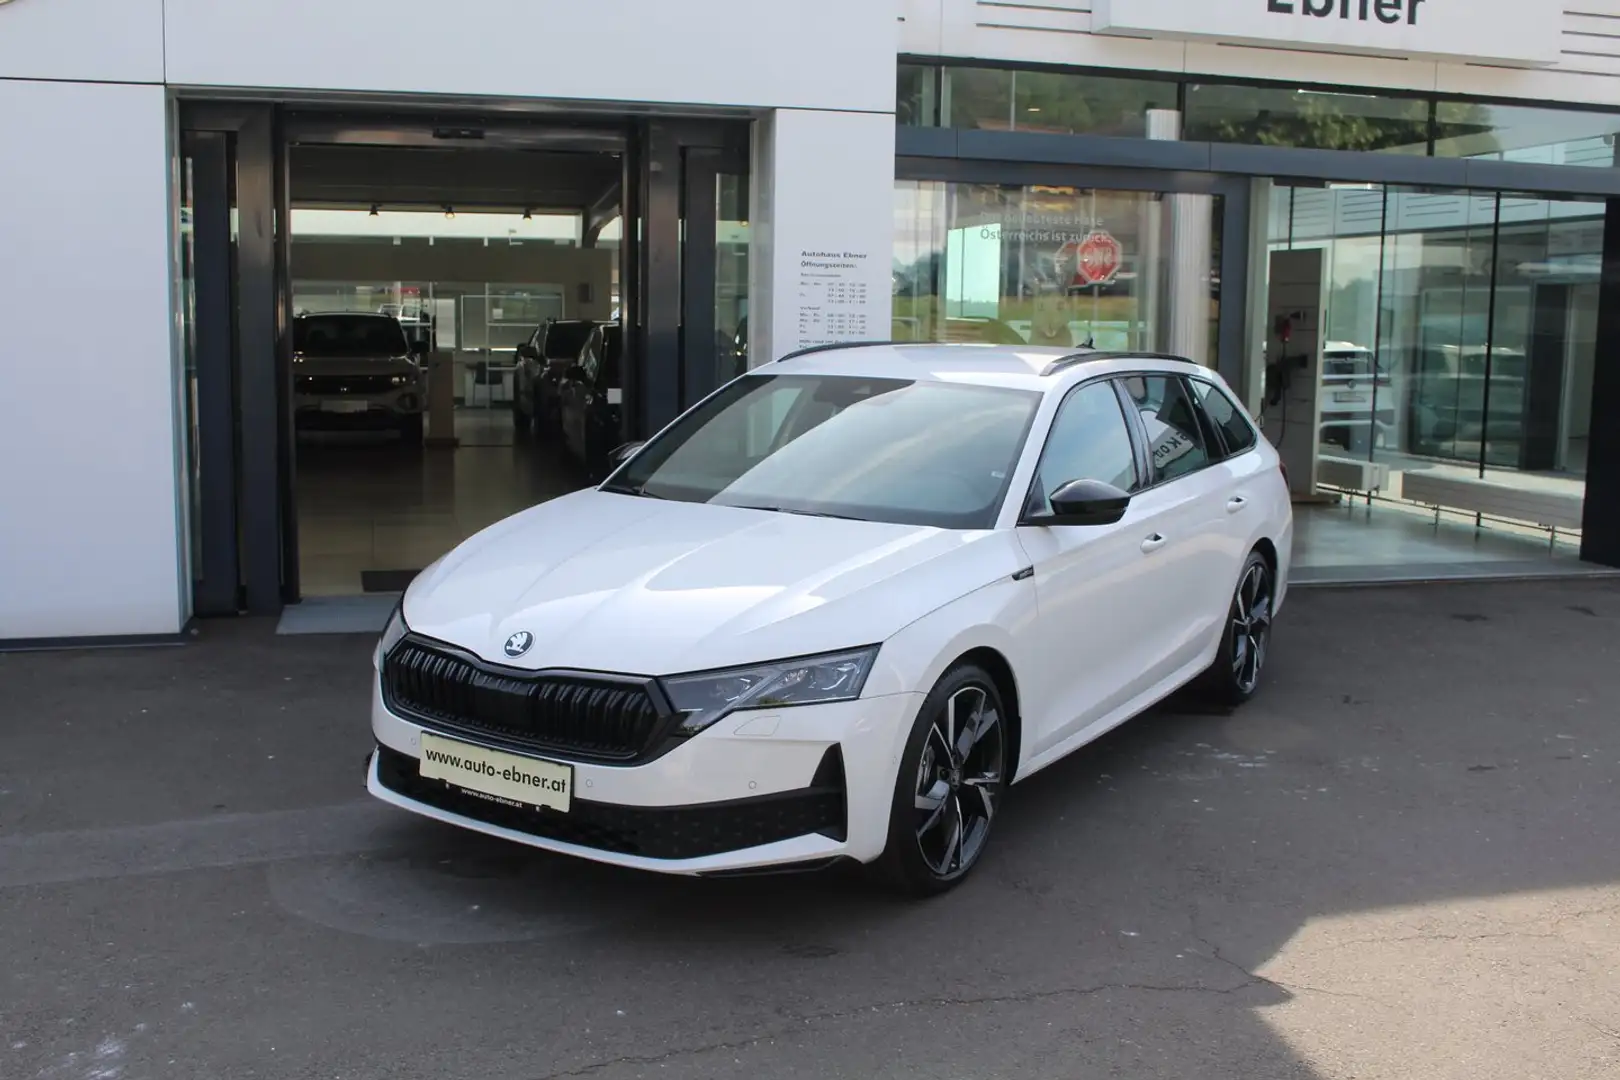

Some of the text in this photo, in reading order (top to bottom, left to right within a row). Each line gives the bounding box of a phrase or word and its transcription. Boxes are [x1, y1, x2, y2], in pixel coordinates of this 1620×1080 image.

[1267, 0, 1425, 25] ner
[980, 225, 1049, 242] Österreichs
[425, 749, 566, 793] www.auto-ebner.at
[461, 788, 523, 809] www.auto-ebner.at
